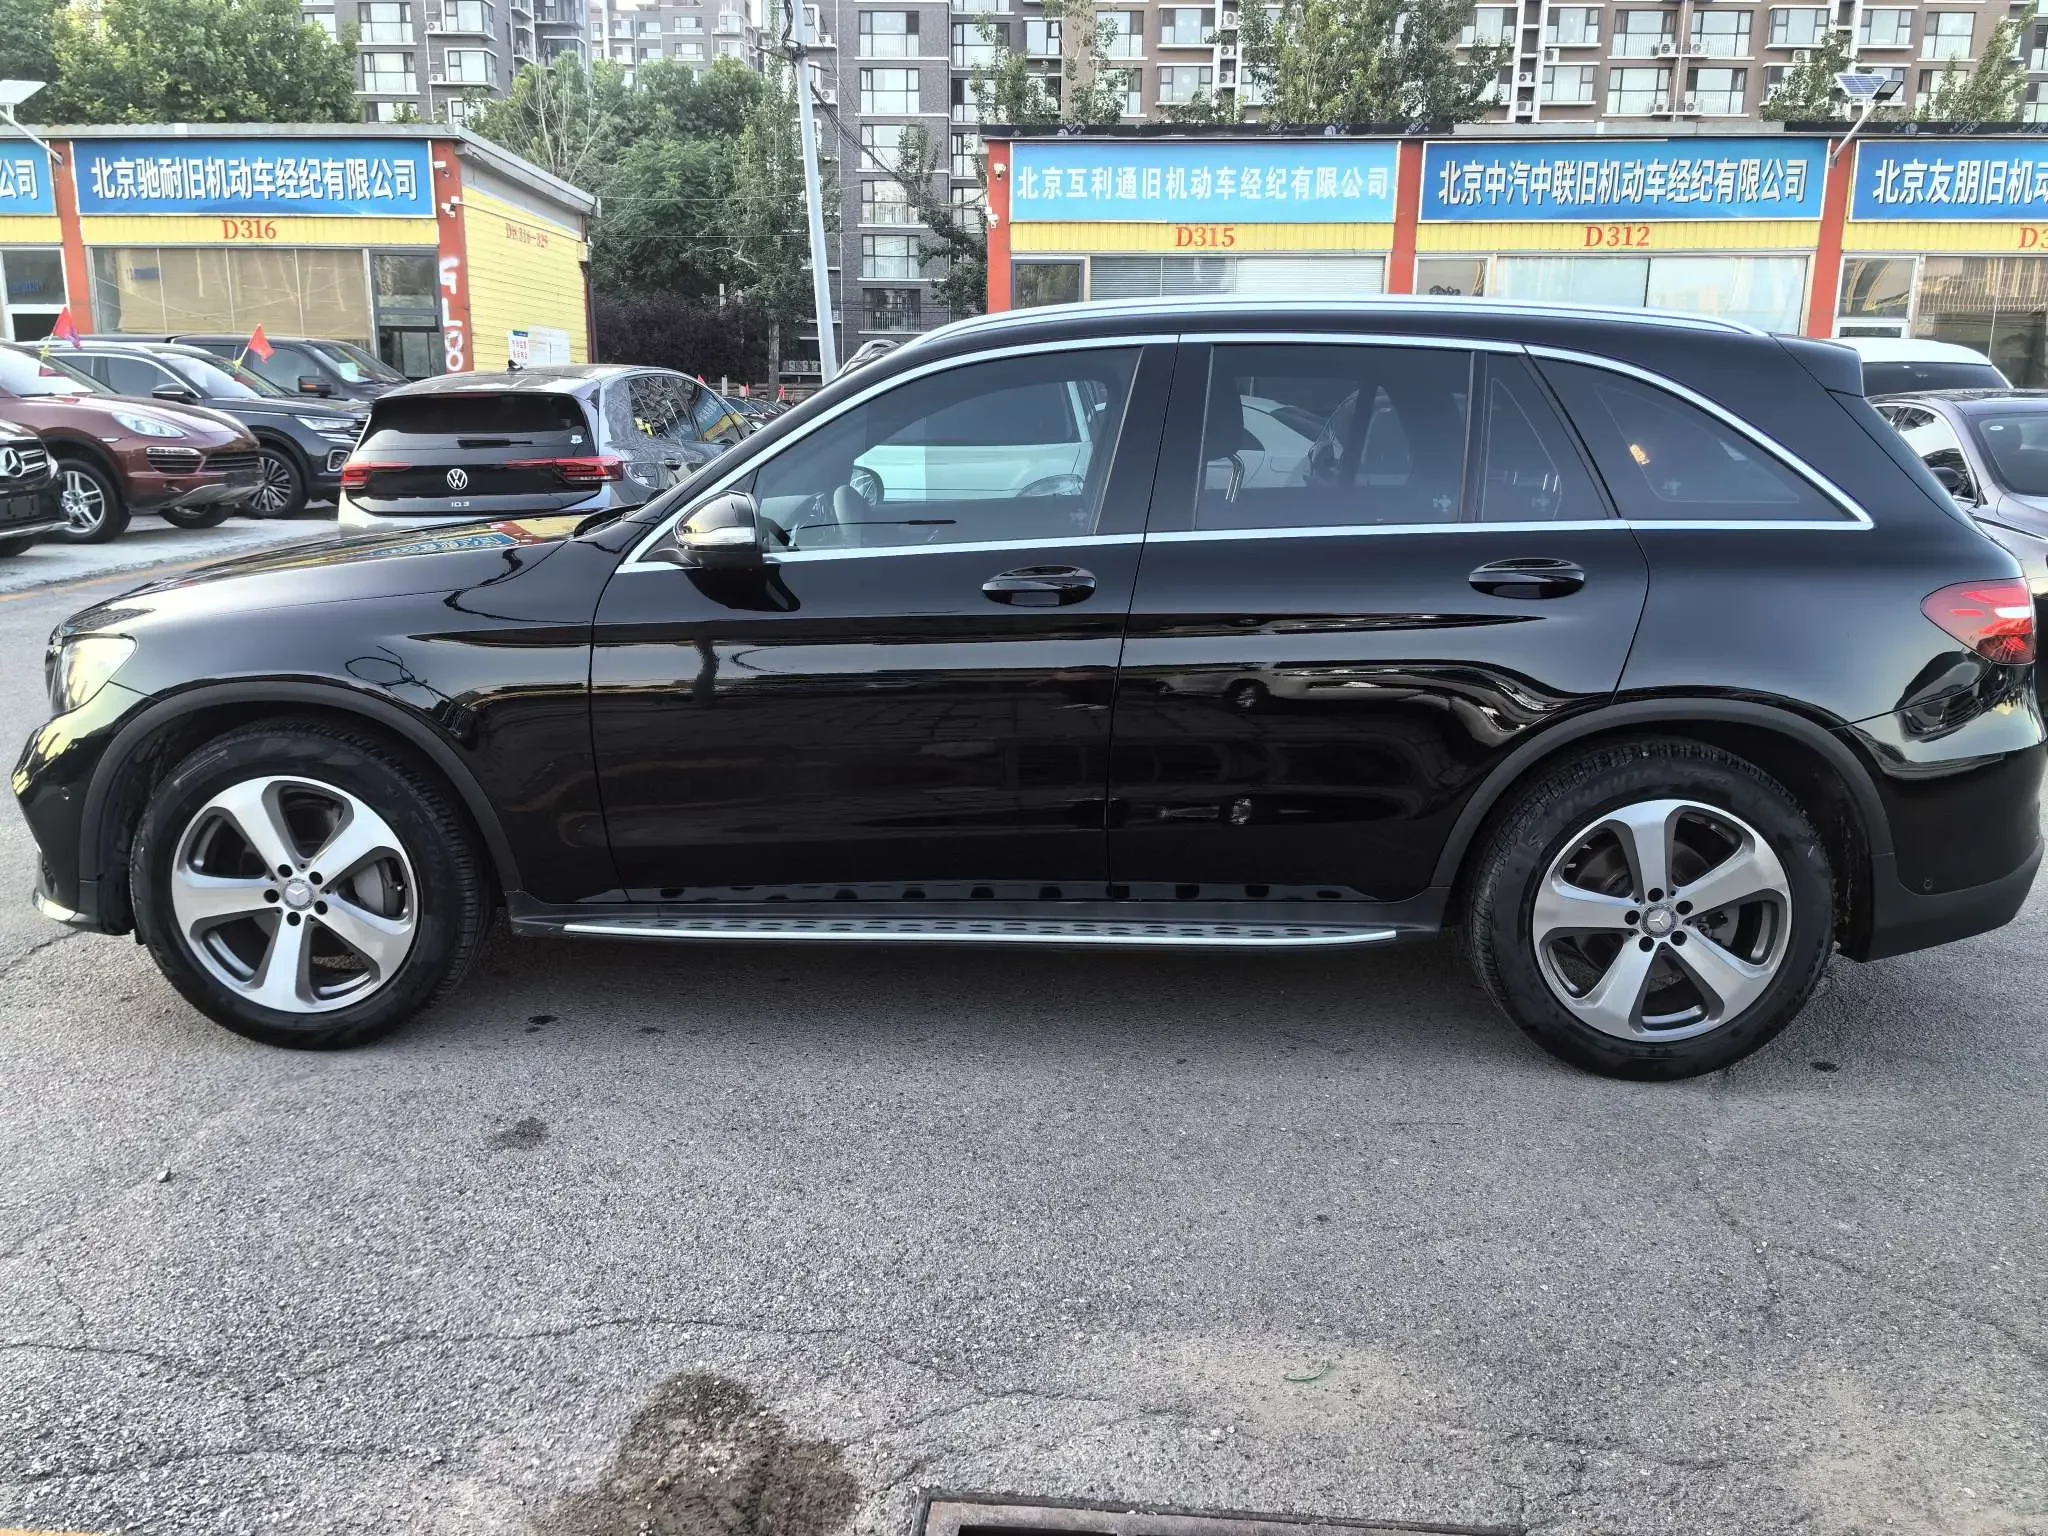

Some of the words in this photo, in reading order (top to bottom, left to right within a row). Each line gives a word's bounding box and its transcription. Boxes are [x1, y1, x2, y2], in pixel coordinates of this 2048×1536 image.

[91, 156, 417, 201] 北京驰耐旧机动车经纪有限公司
[1016, 166, 1389, 200] 北京互利通旧机动车经纪有限公司
[1438, 158, 1808, 205] 北京中汽中联旧机动车经纪有限公司
[222, 219, 277, 240] D316
[1175, 226, 1236, 247] D315
[1583, 225, 1651, 248] D312
